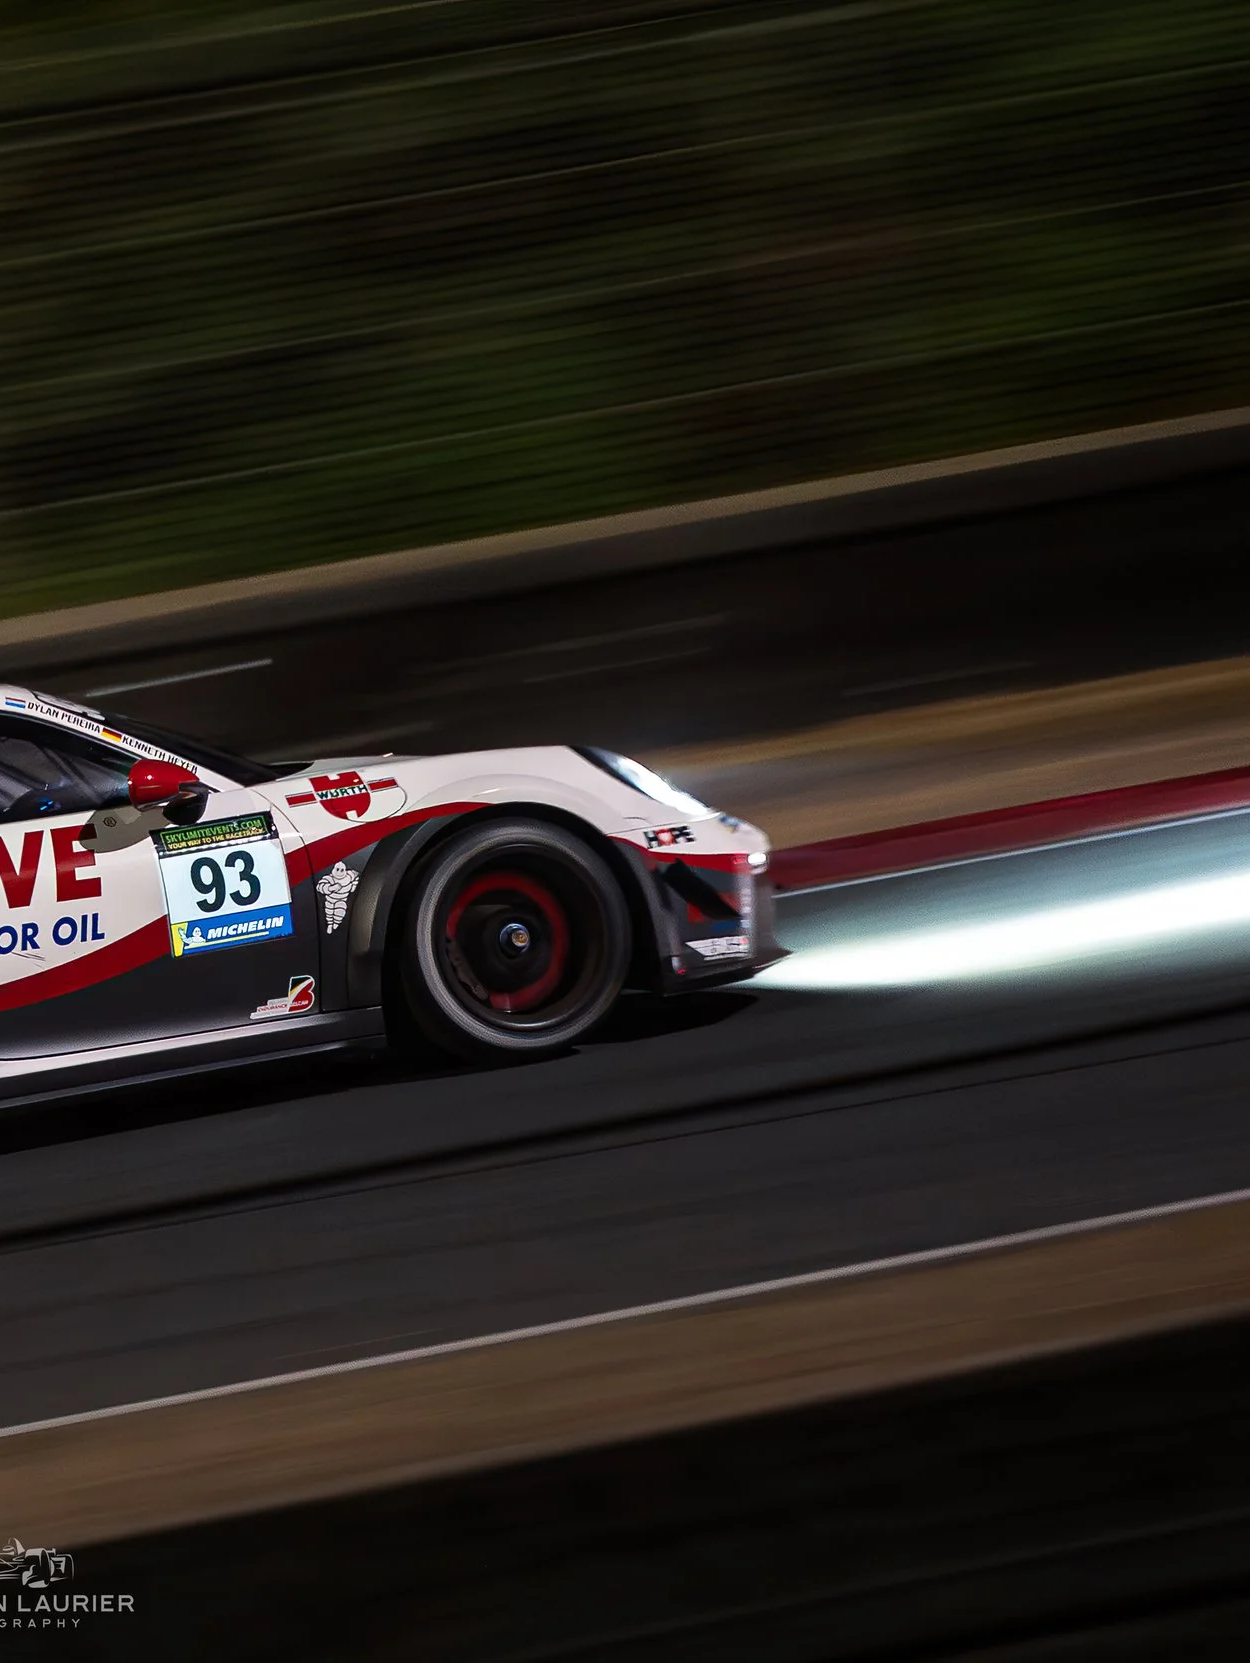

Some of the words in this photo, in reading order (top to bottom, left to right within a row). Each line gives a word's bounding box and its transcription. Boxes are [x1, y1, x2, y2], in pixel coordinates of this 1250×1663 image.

[27, 702, 60, 719] DYLAN
[61, 712, 101, 734] PEREIRA
[122, 735, 167, 761] KENNETH
[165, 819, 262, 843] SKYLIMITEVENTS.COM
[167, 841, 187, 850] YOUR
[187, 838, 201, 847] WAY
[190, 850, 261, 913] 93
[52, 912, 105, 947] OIL
[207, 915, 285, 941] MICHELIN
